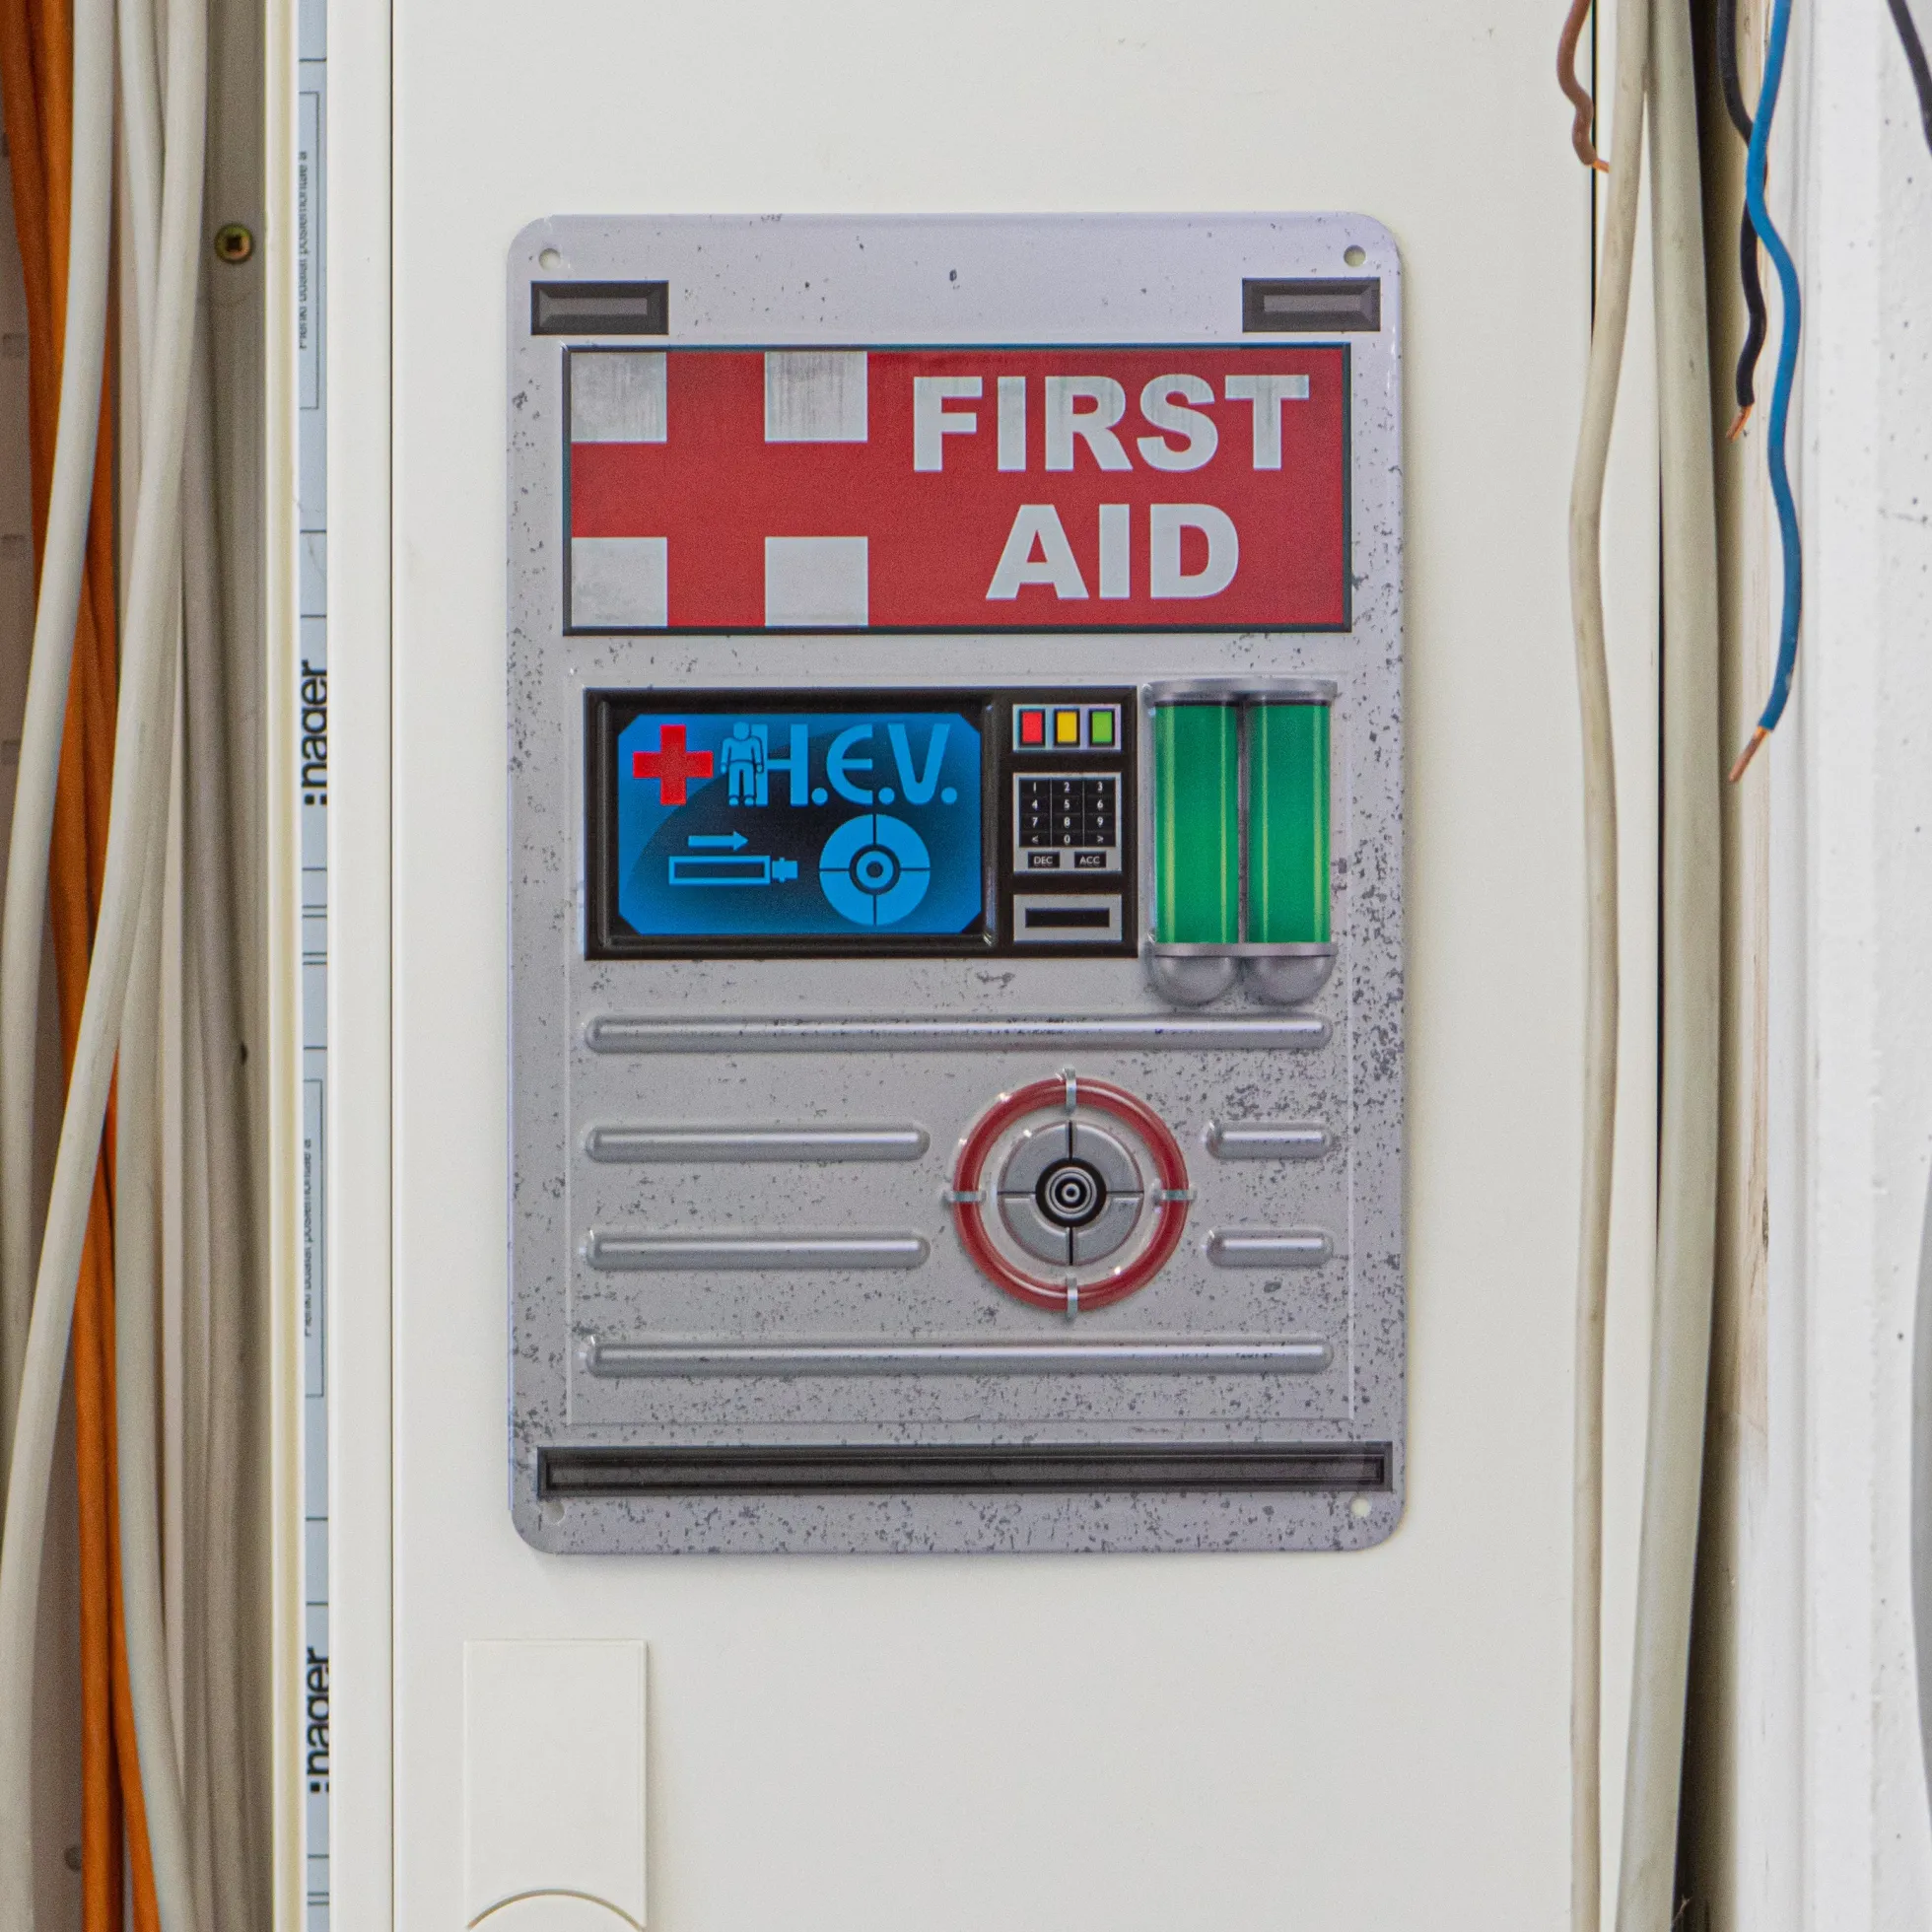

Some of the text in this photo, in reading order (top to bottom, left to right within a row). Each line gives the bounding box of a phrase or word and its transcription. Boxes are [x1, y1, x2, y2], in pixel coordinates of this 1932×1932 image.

[913, 375, 1310, 472] FIRST
[986, 504, 1239, 600] AID
[750, 723, 958, 806] H.E.V.
[1064, 782, 1070, 793] 2
[1097, 782, 1103, 793] 3
[1032, 799, 1103, 809] 4 5 6
[1032, 817, 1103, 827] 7 8 9
[1064, 835, 1070, 845] 0
[1033, 856, 1053, 865] DEC
[1079, 856, 1101, 865] ACC
